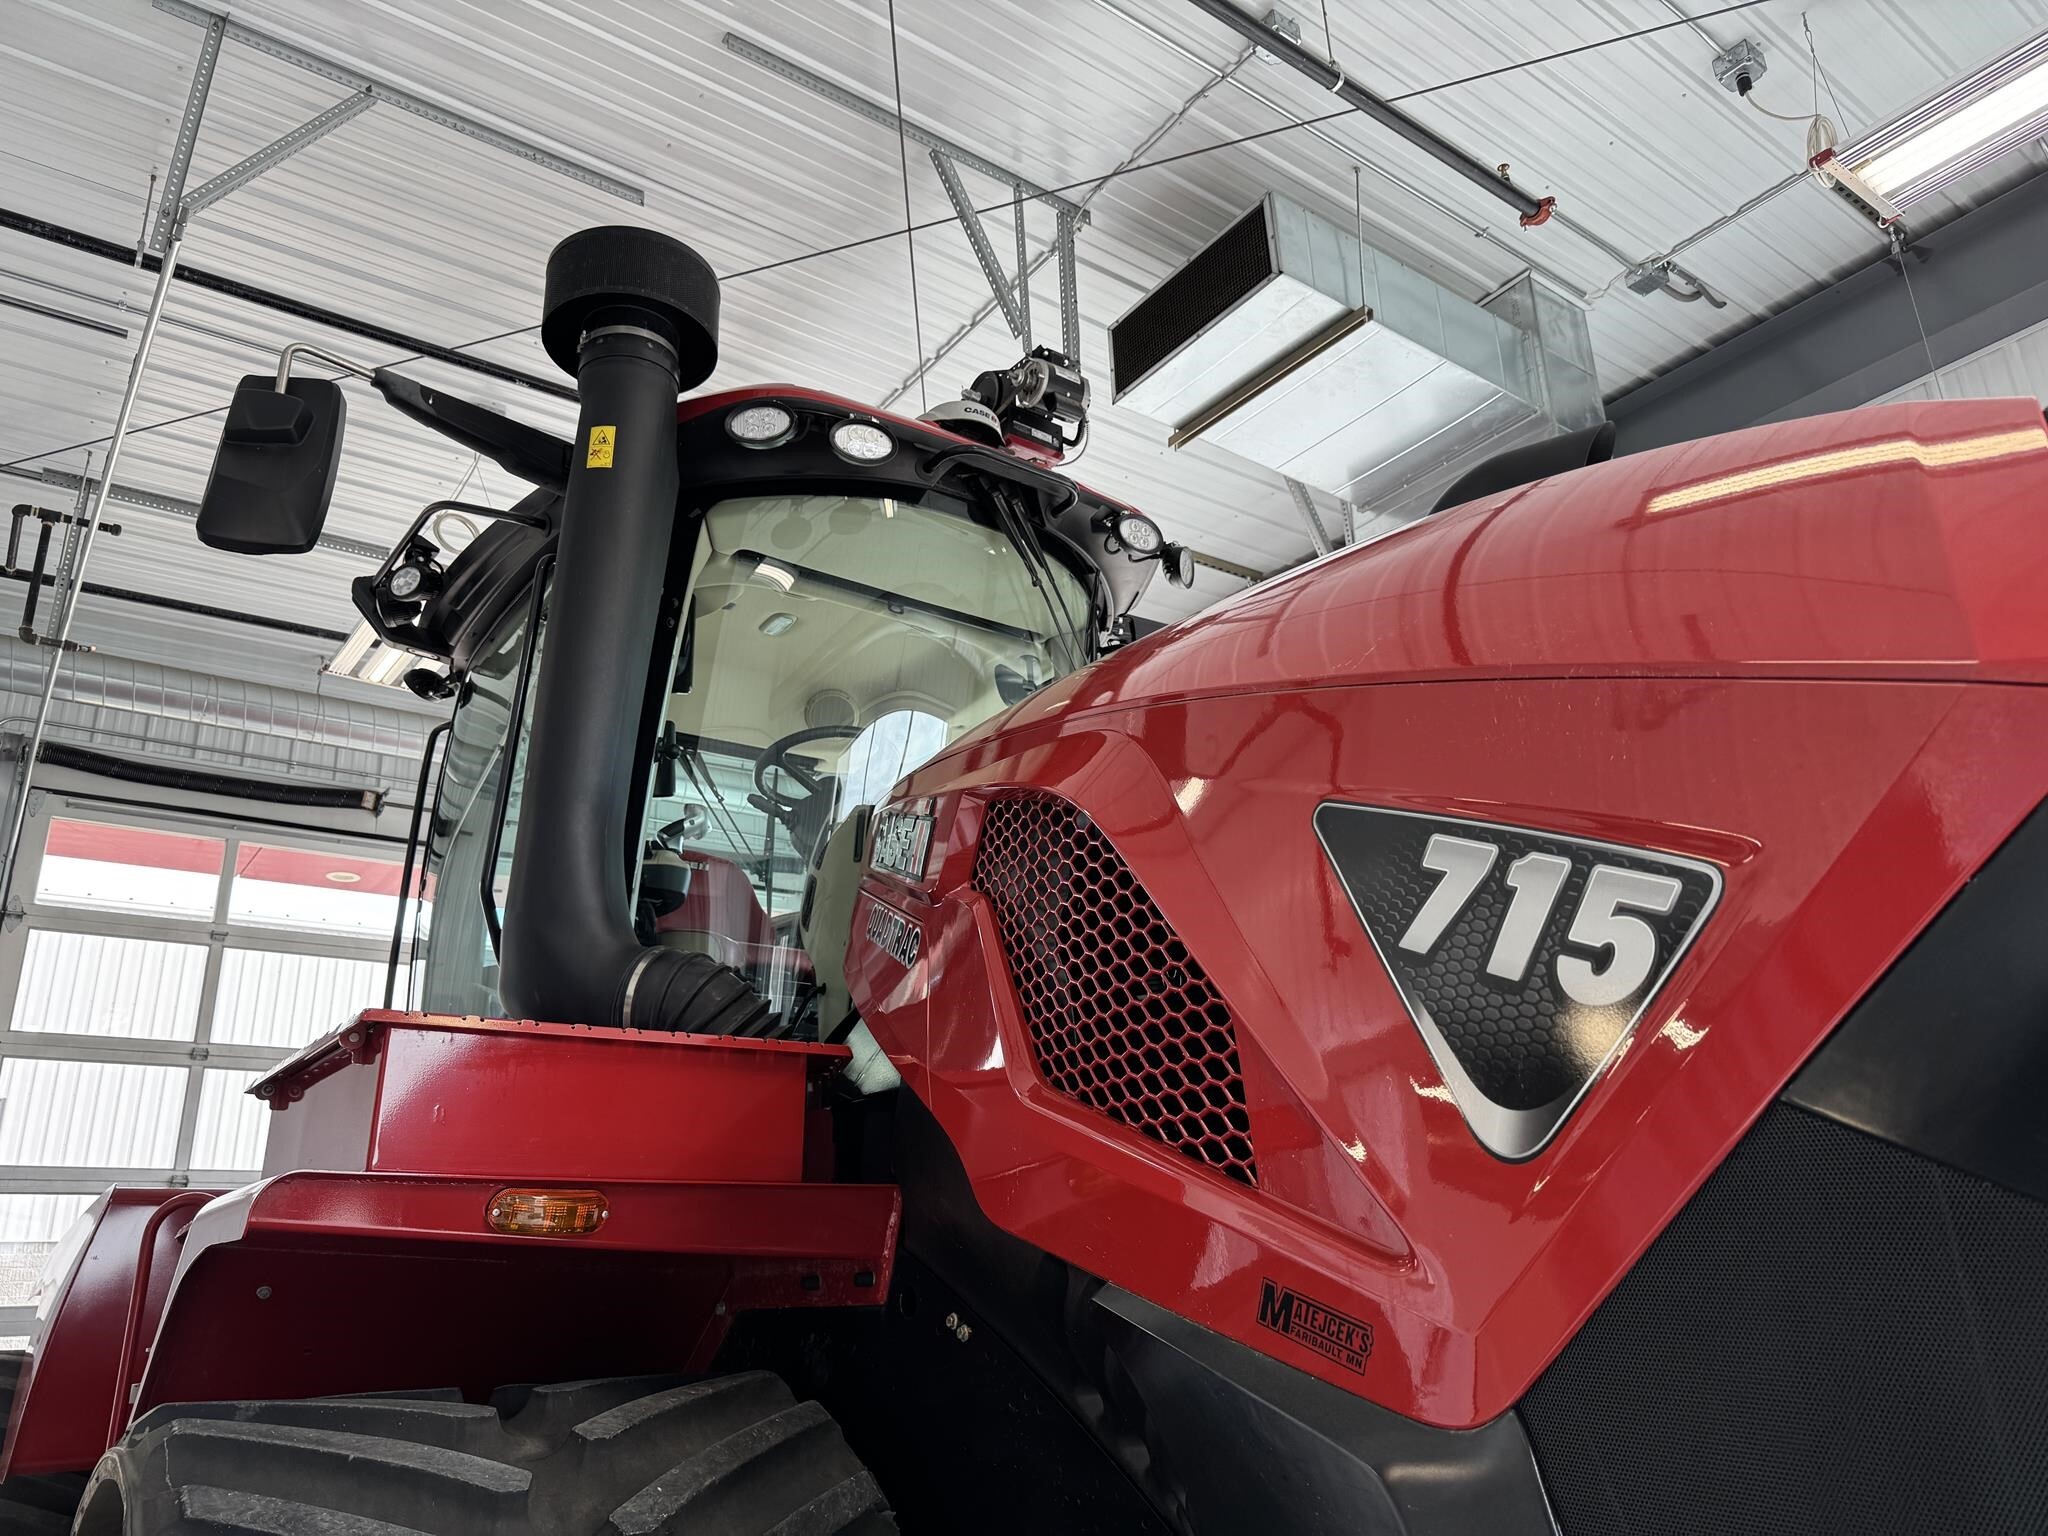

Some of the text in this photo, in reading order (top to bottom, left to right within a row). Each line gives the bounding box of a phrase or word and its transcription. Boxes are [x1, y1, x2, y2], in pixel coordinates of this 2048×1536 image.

[965, 407, 990, 419] CASE
[866, 903, 921, 969] QUADTRAC
[1399, 833, 1682, 1006] 715
[1260, 1283, 1370, 1353] MATEJCEK'S
[1345, 1354, 1363, 1369] MN
